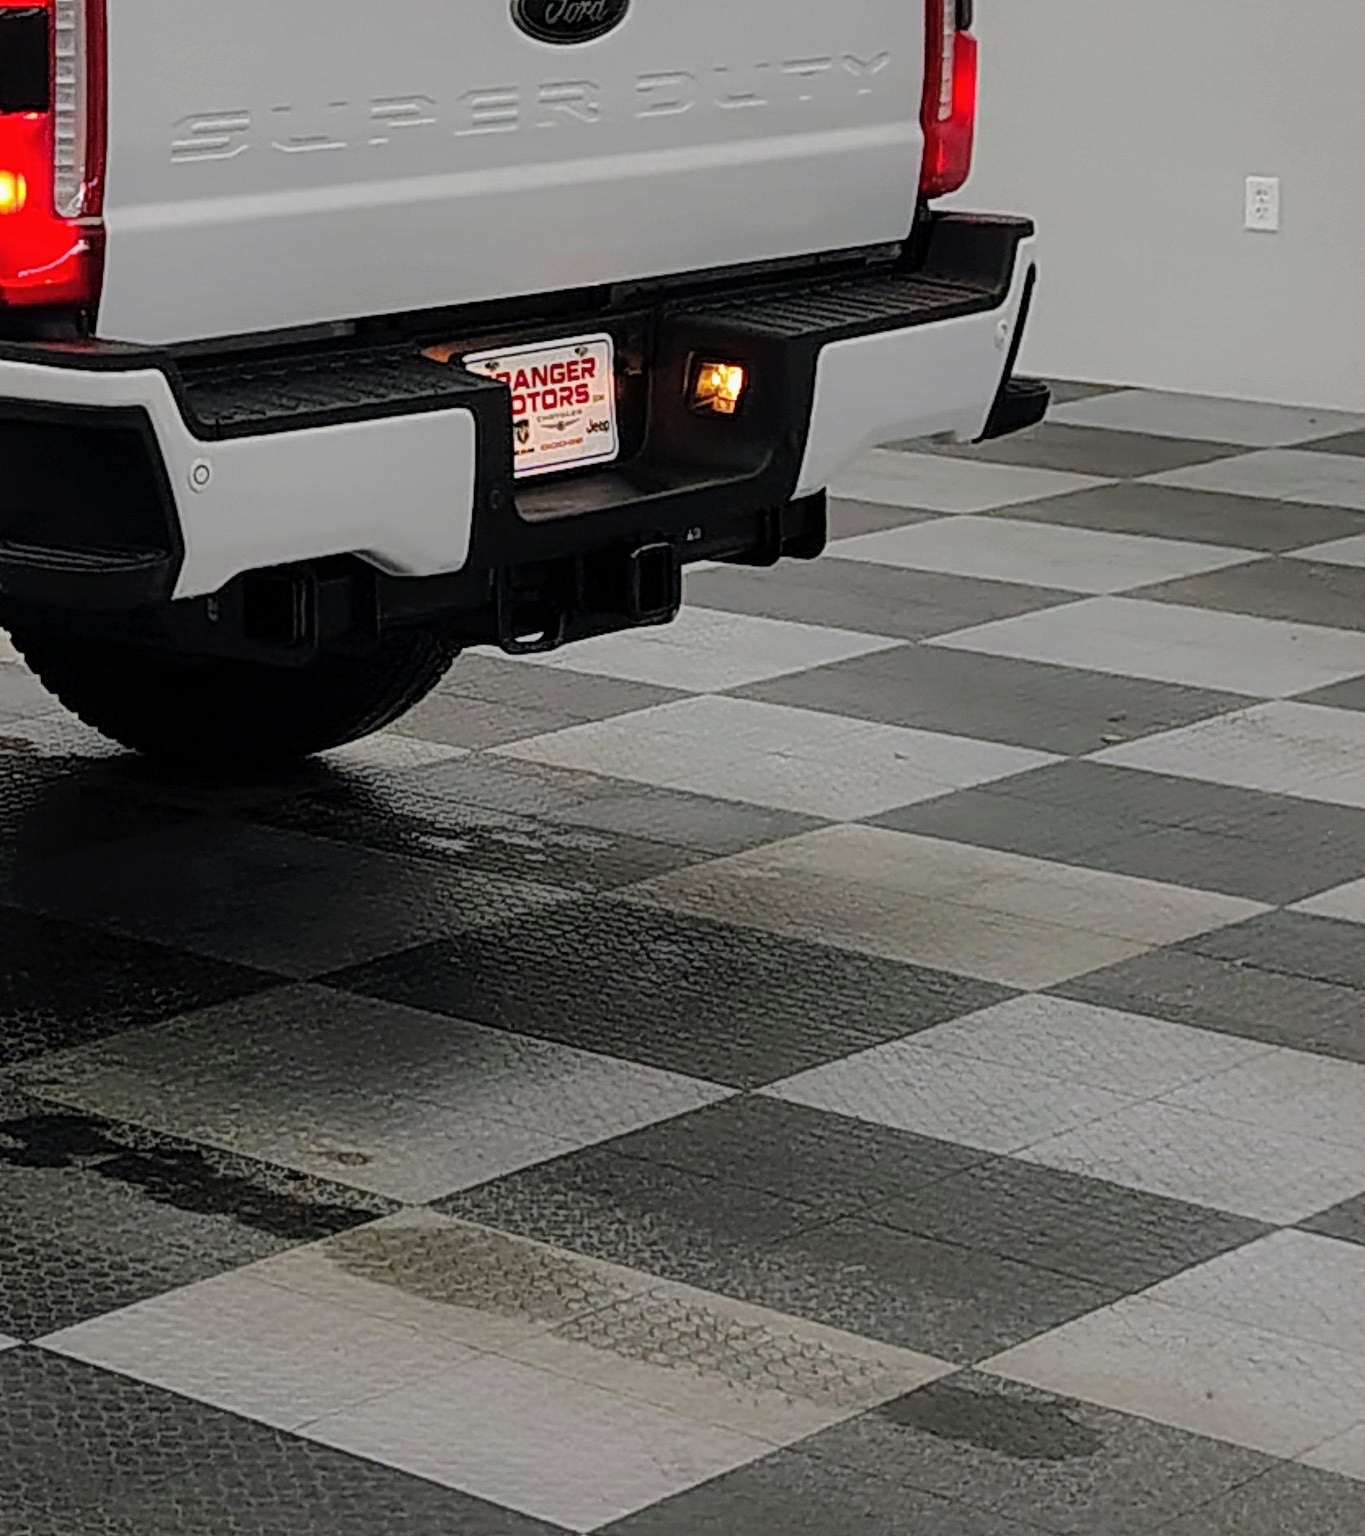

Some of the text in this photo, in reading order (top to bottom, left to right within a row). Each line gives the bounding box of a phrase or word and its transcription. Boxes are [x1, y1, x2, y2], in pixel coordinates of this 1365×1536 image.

[169, 50, 891, 164] SUPER DUTY
[485, 356, 596, 392] ANGER
[512, 383, 589, 415] OTORS
[586, 418, 610, 434] Jeep
